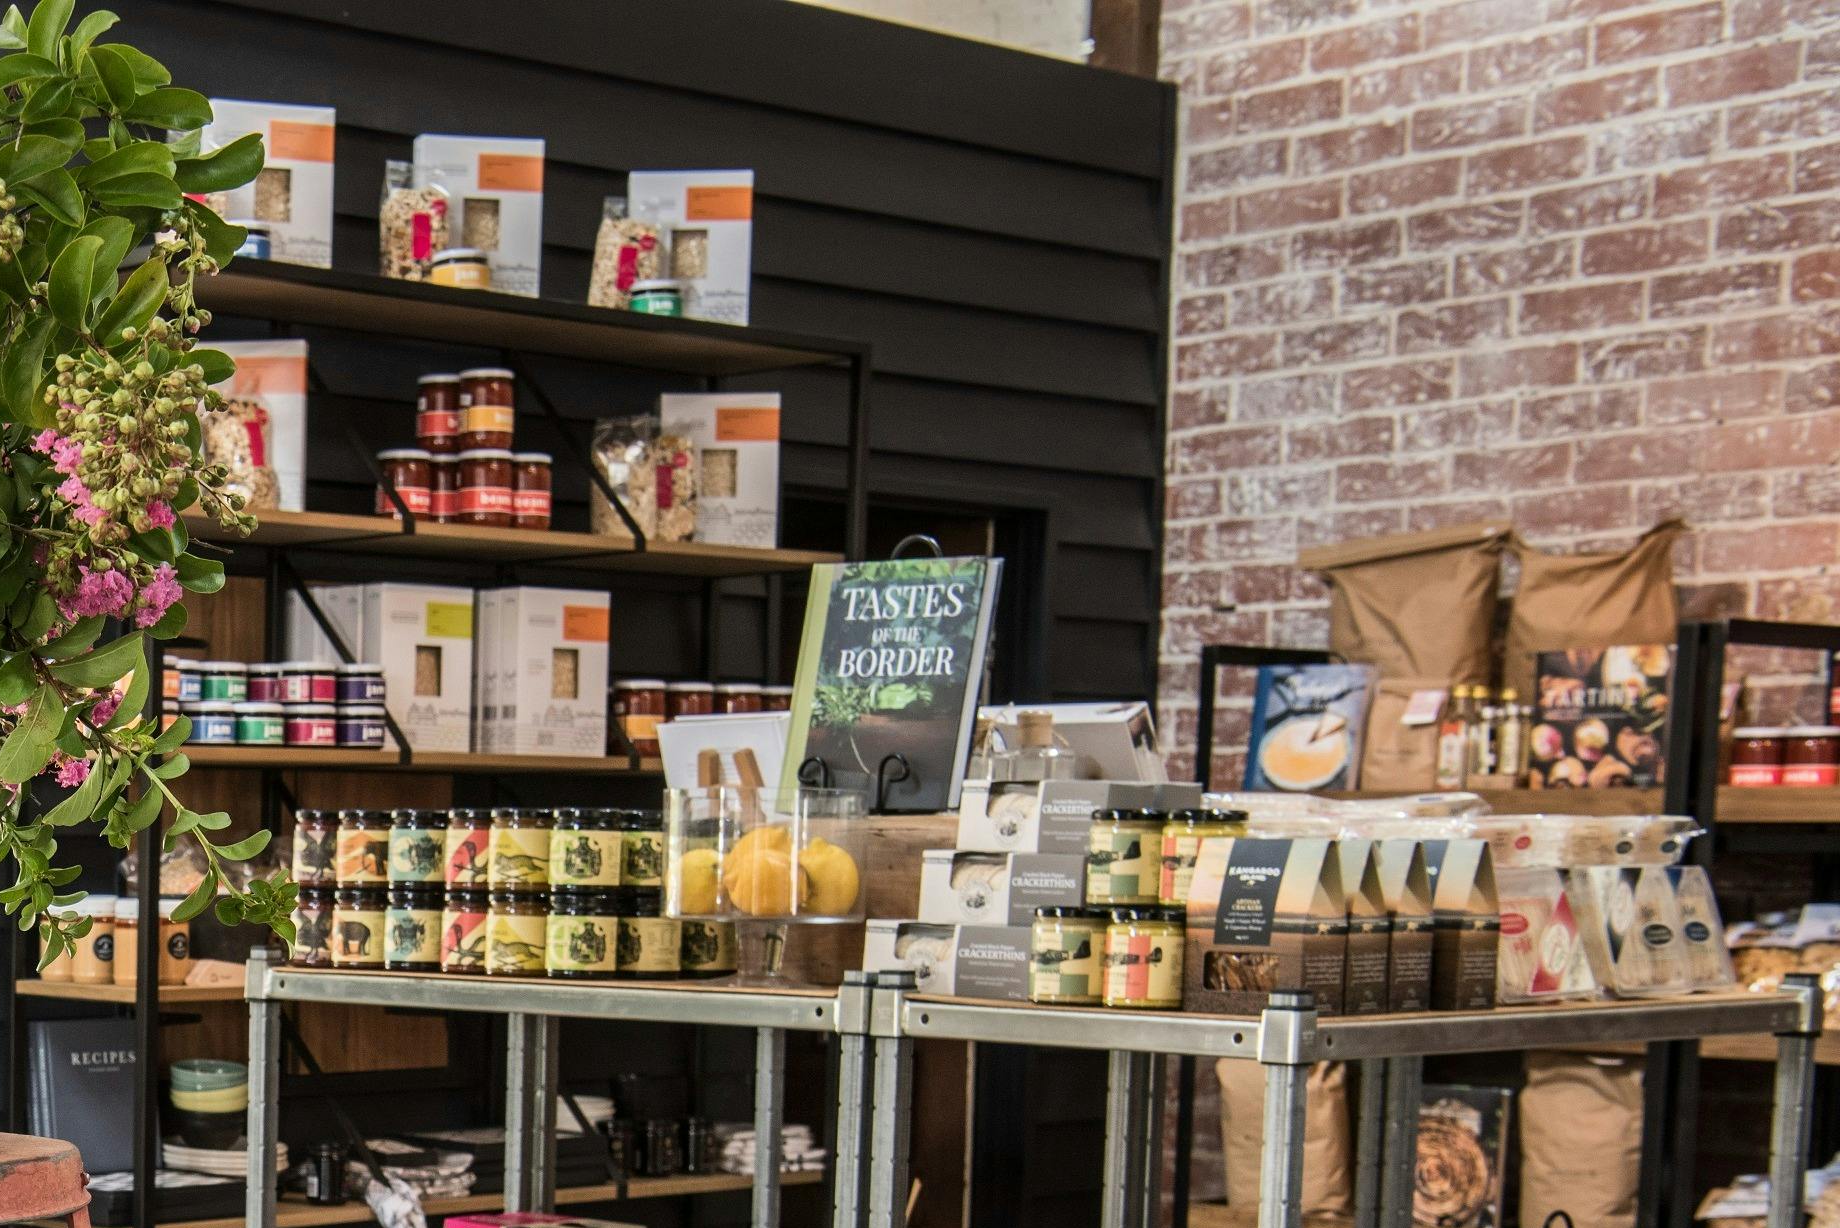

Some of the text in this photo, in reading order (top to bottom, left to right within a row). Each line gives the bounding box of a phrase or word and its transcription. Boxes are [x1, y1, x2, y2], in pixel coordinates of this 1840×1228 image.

[841, 582, 965, 621] TASTES
[871, 626, 922, 642] OF THE
[837, 646, 955, 678] BORDER
[1228, 866, 1281, 877] KANGAROO
[1011, 876, 1076, 889] CRACKERTHINS
[958, 947, 1027, 962] CRACKERTHINS
[71, 1050, 137, 1066] RECIPES
